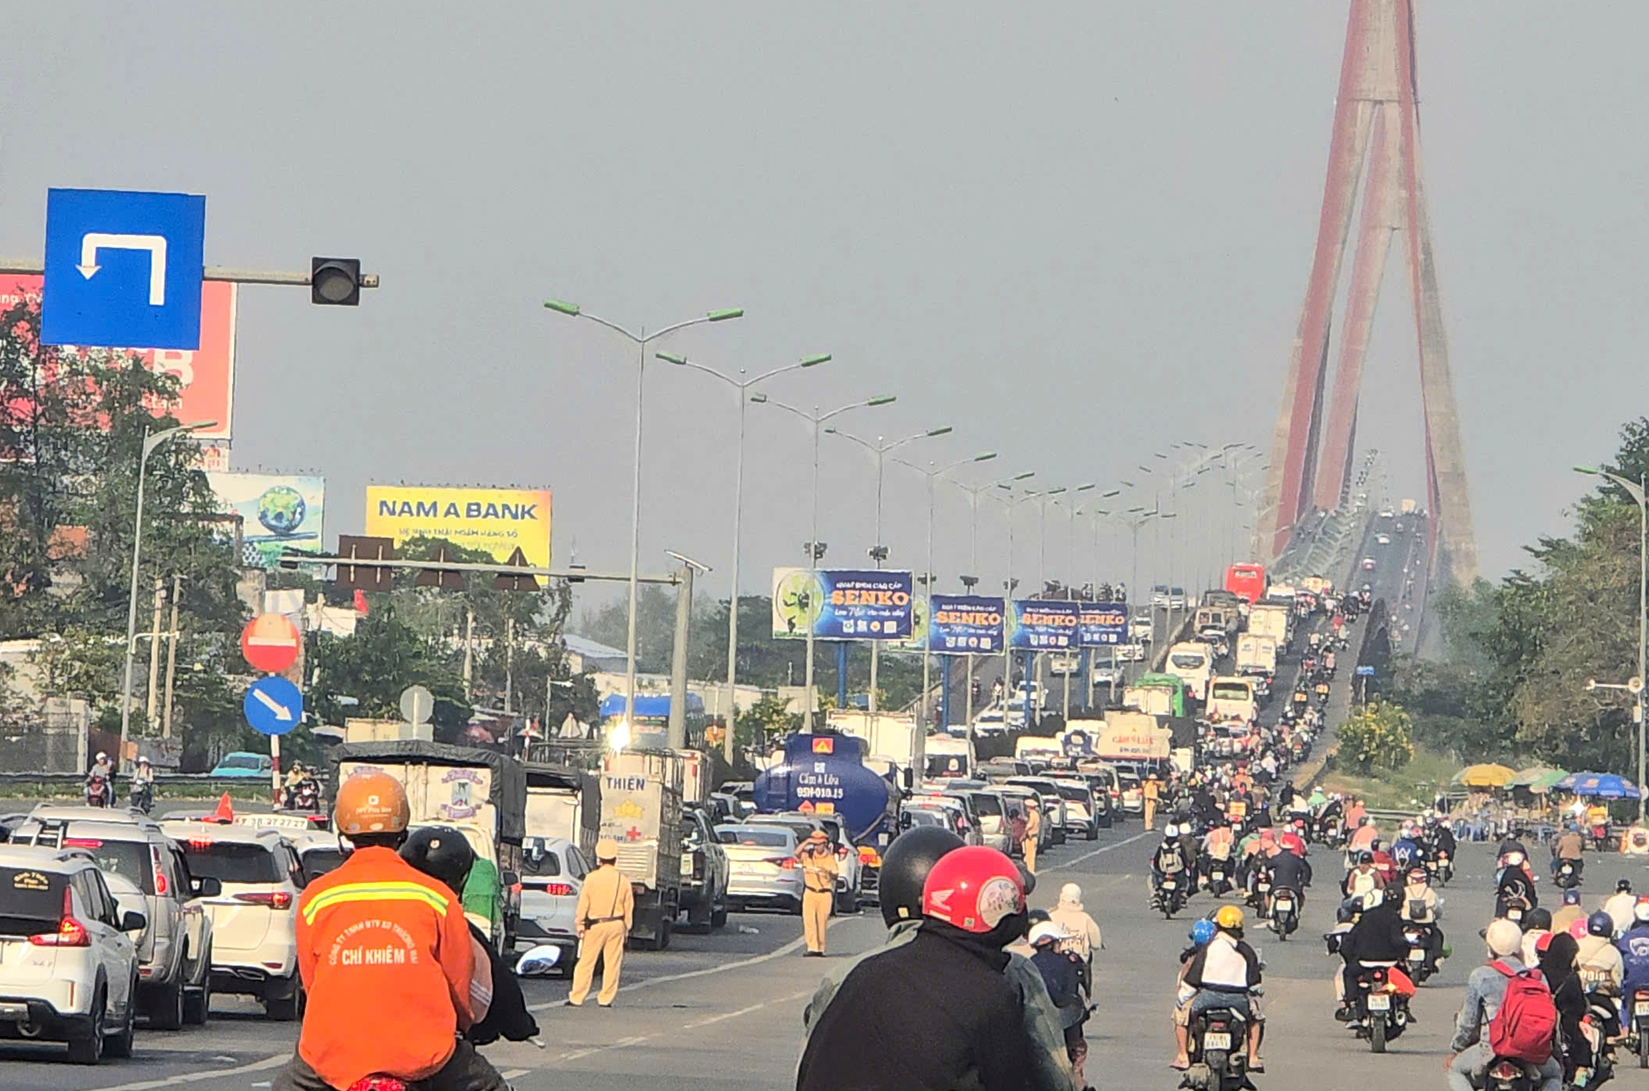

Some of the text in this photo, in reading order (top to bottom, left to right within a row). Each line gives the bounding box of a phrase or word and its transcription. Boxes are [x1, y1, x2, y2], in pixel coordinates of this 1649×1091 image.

[378, 500, 538, 520] NAM A BANK
[830, 590, 909, 606] SENKO
[936, 611, 1000, 626] SENKO
[1021, 613, 1077, 626] SENKO
[342, 944, 405, 965] CHÍ KHIÊM
